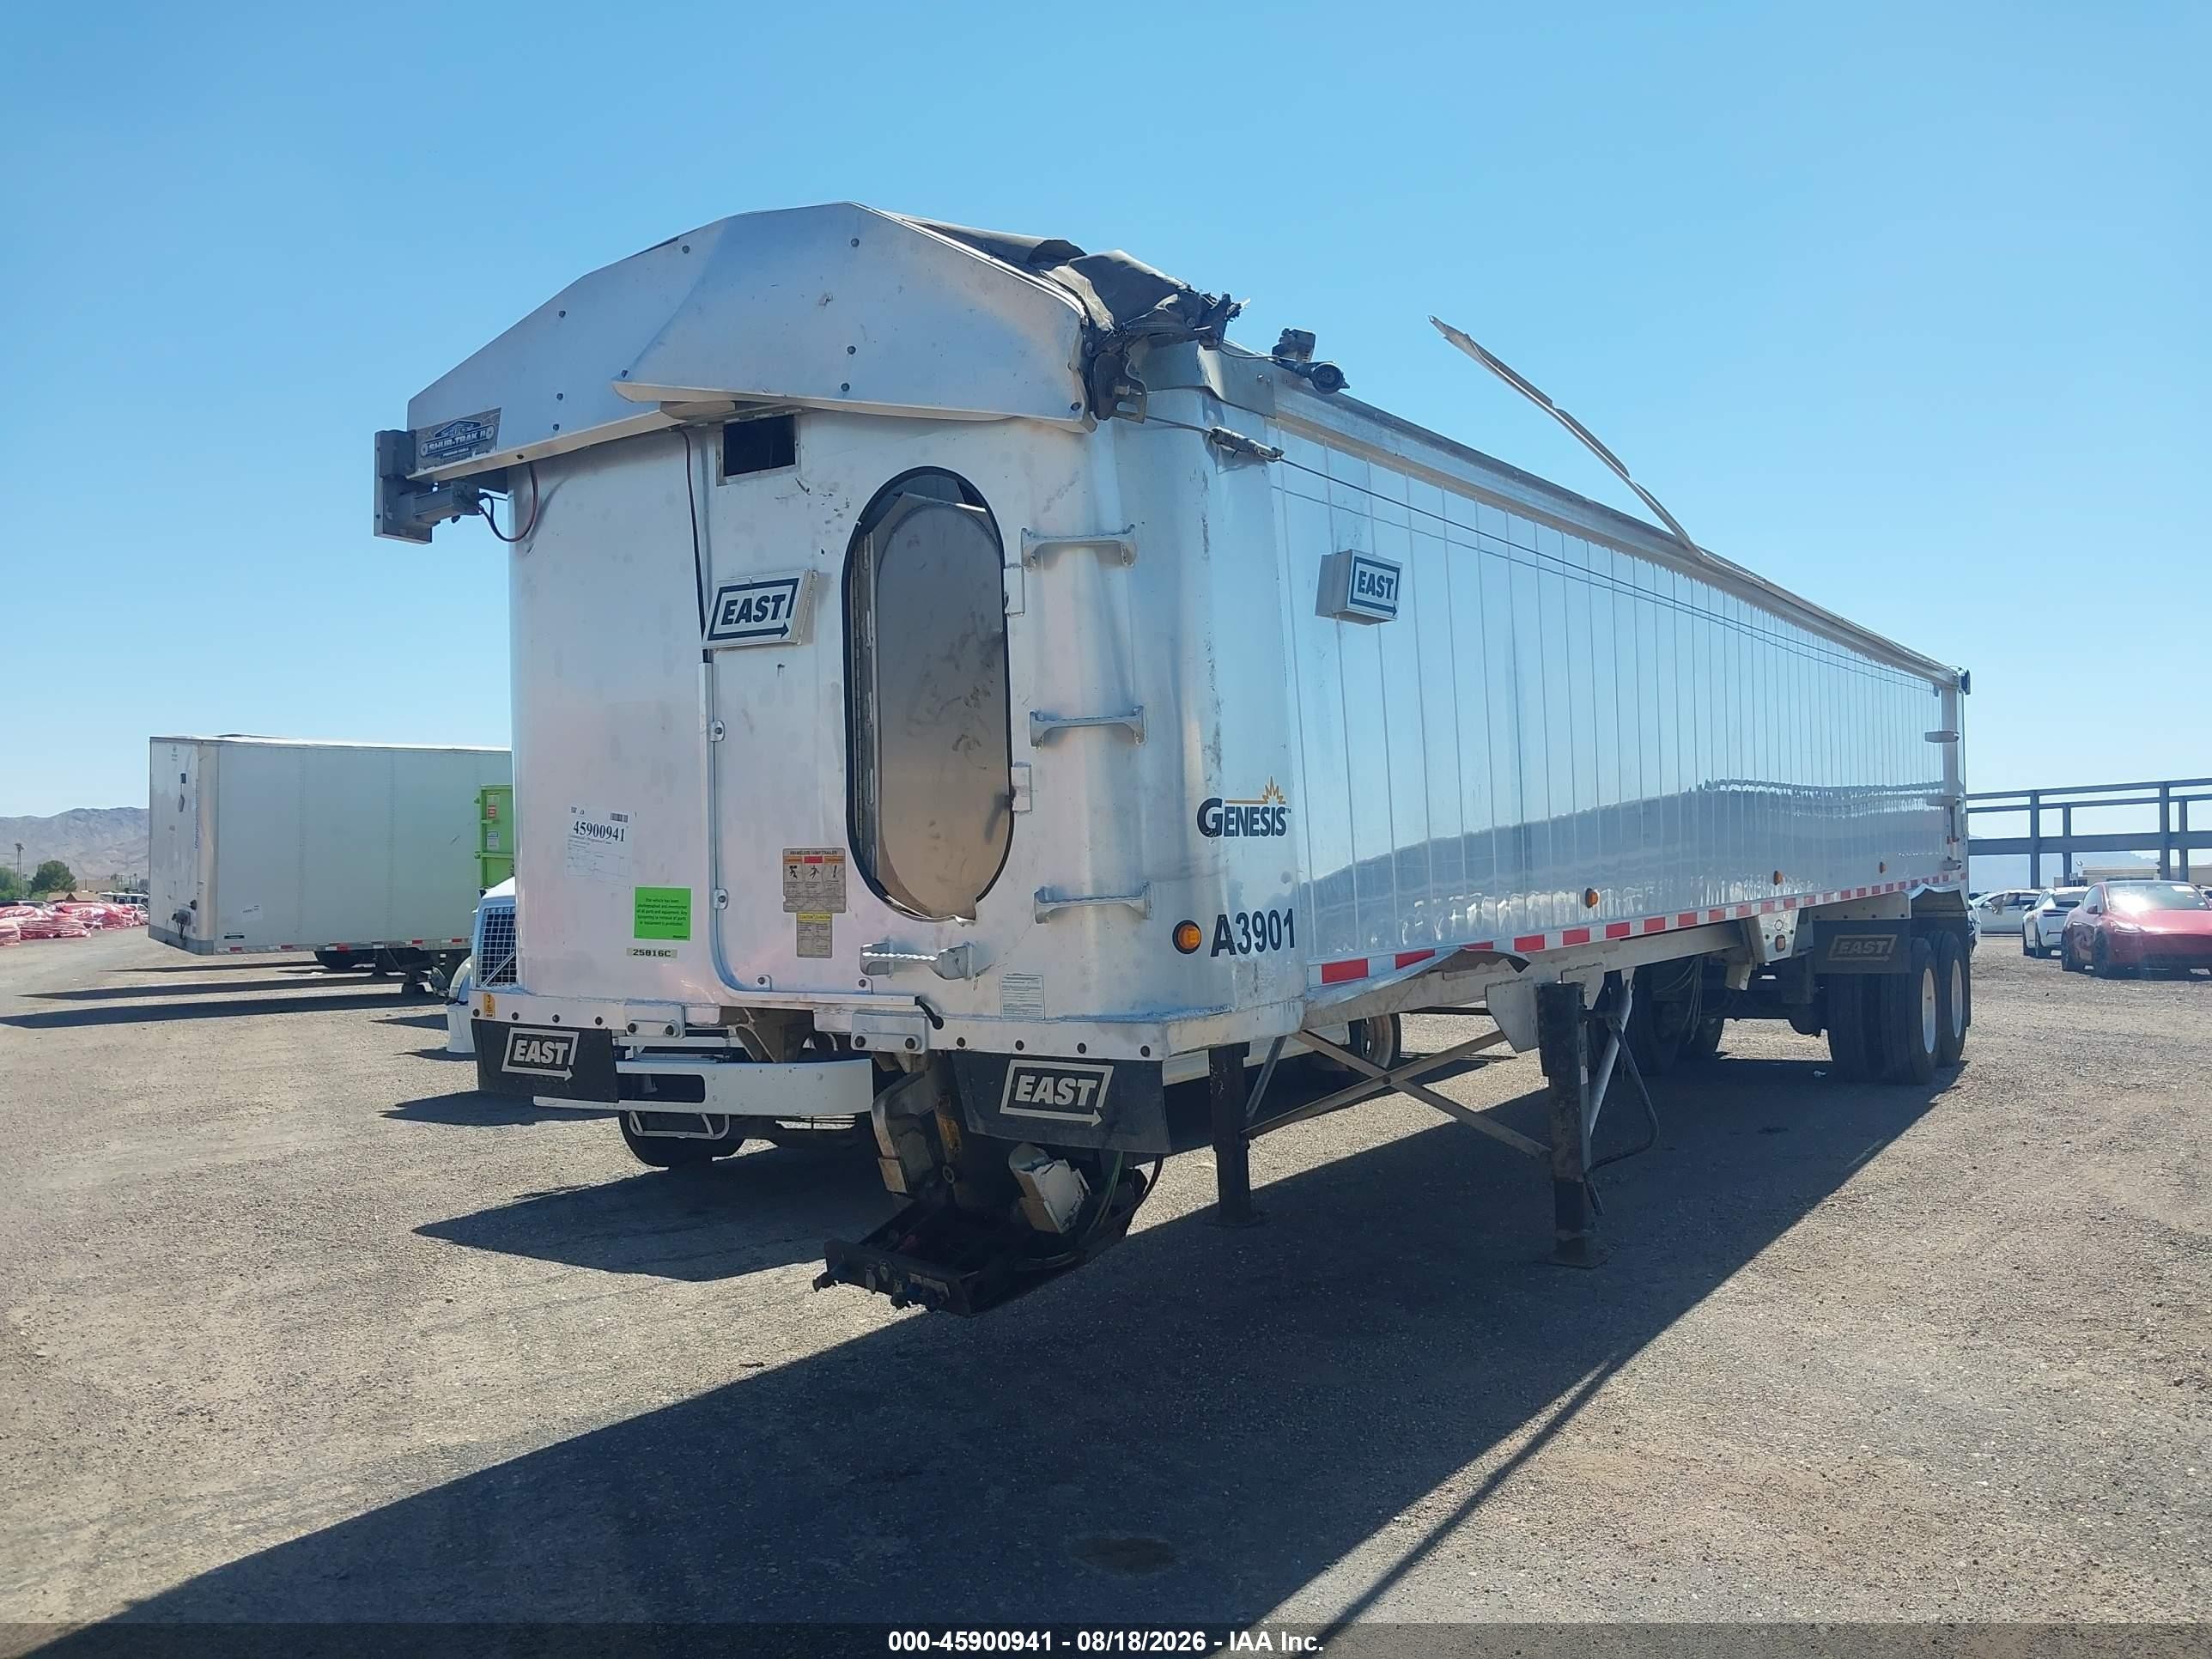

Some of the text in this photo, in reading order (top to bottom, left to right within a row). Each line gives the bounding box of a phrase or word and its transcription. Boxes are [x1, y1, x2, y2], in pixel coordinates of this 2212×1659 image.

[1357, 570, 1395, 599] EAST
[720, 593, 787, 626] EAST
[573, 820, 625, 842] 45900941
[1196, 797, 1287, 838] GENESIS
[1209, 908, 1296, 957] A3901
[1838, 940, 1887, 954] EAST
[513, 1039, 569, 1065] EAST
[1014, 1074, 1097, 1107] EAST
